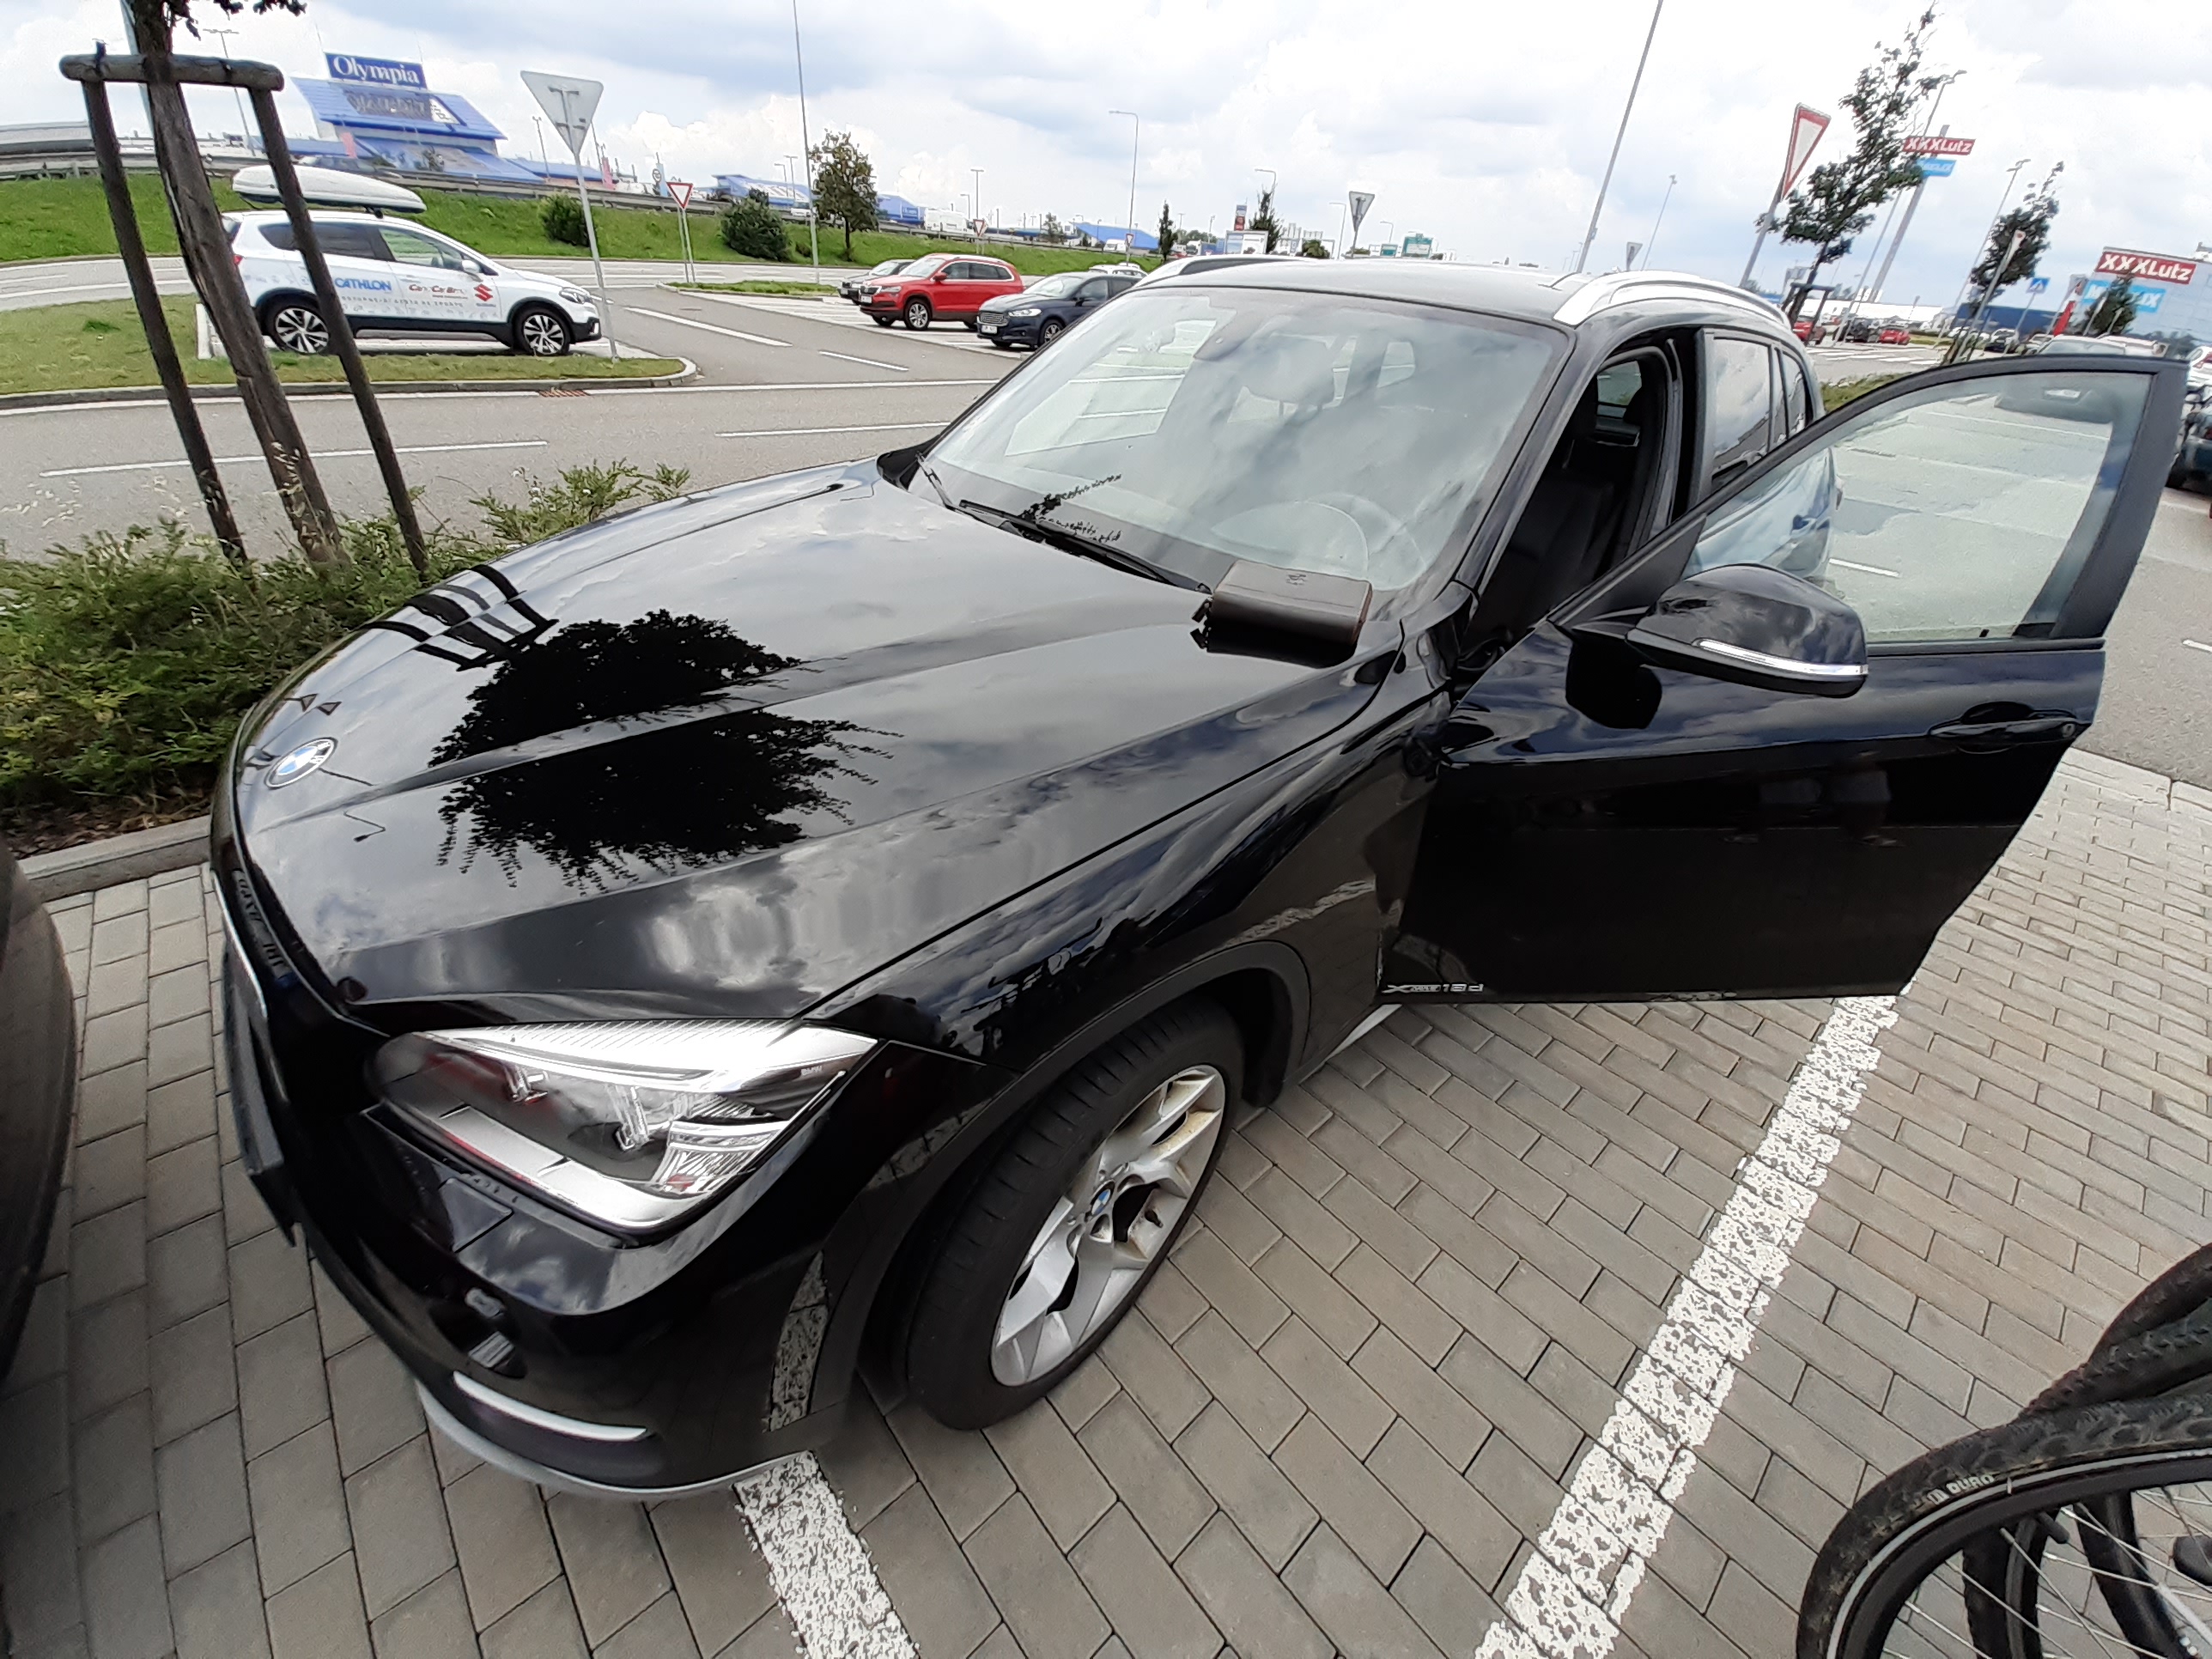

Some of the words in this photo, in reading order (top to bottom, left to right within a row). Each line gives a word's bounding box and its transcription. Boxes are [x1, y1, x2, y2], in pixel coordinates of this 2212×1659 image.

[333, 56, 421, 84] Olympia
[1905, 137, 1972, 153] XXXLutz
[2099, 253, 2193, 281] XXXLutz
[334, 277, 392, 291] CATHLON
[1946, 1474, 1995, 1494] DURO
